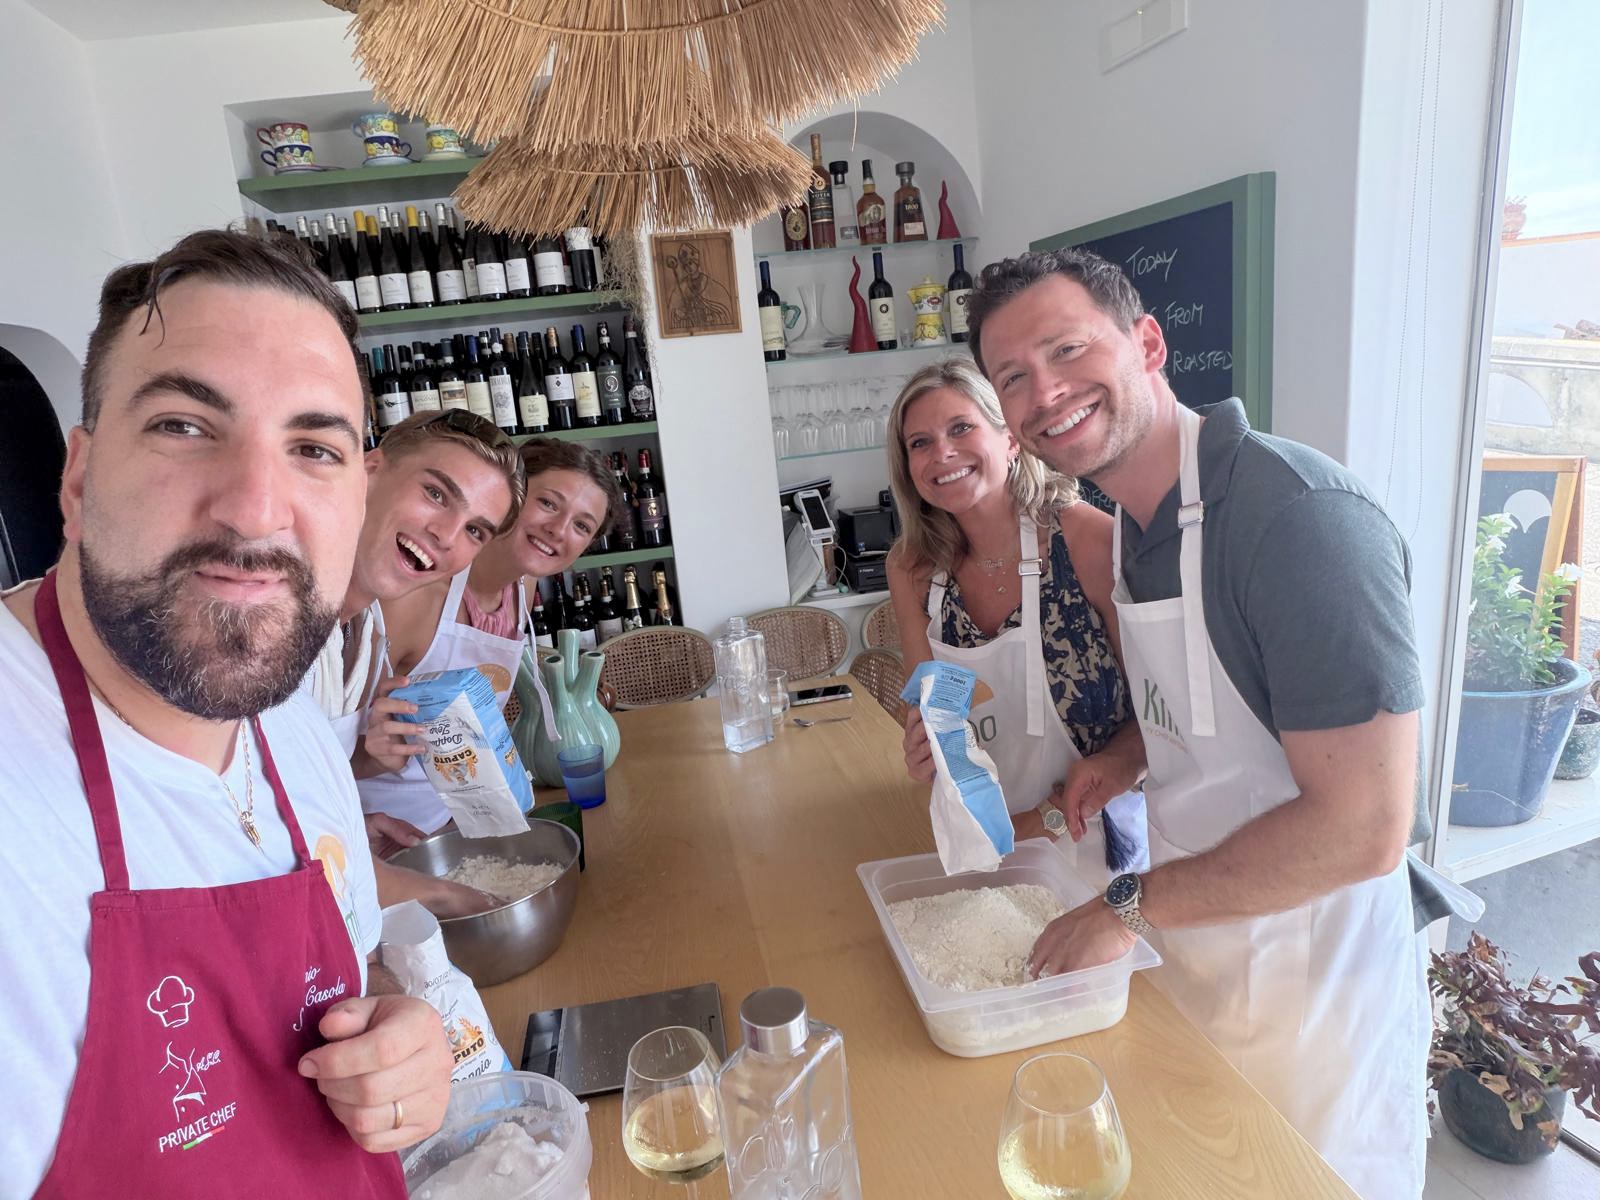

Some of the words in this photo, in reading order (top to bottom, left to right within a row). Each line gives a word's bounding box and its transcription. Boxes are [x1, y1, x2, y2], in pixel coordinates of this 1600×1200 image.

[1165, 301, 1203, 331] FROM
[1173, 350, 1232, 376] ROASTED
[434, 749, 473, 764] CAPUTO
[305, 975, 346, 1007] Casola
[454, 1036, 485, 1064] PUTO
[158, 1117, 210, 1153] PRIVATE
[209, 1102, 237, 1127] CHEF
